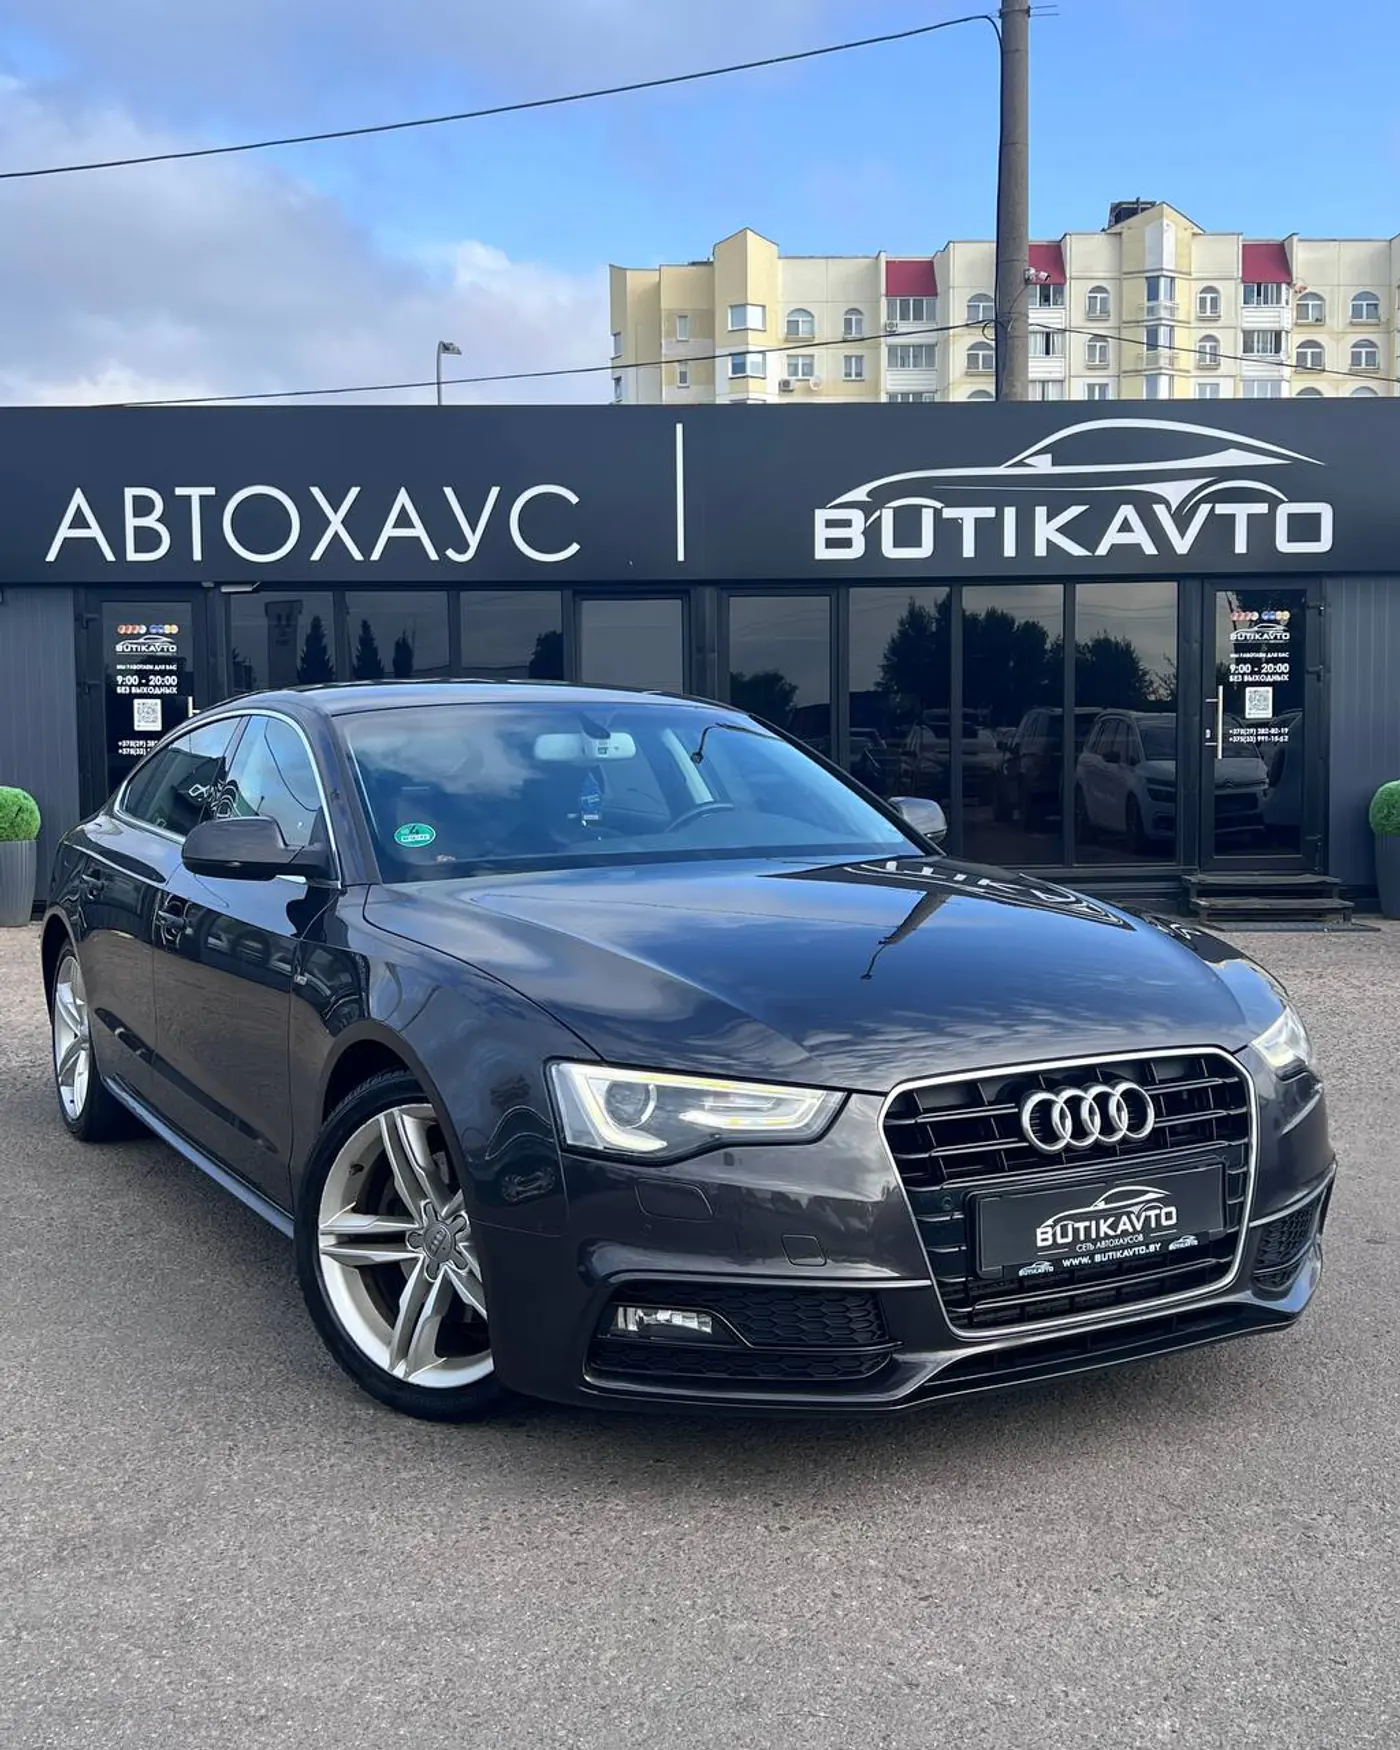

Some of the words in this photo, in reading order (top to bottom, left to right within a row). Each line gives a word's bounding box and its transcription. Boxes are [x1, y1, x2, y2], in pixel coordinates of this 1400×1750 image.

[45, 484, 581, 563] АВТОХАУС
[814, 500, 1334, 560] BUTIKAVTO
[1230, 632, 1290, 640] BUTIKAVTO
[115, 644, 177, 652] BUTIKAVTO
[1229, 664, 1252, 674] 9:00
[1260, 663, 1290, 673] 20:00
[116, 675, 140, 686] 9:00
[148, 675, 178, 686] 20:00
[1229, 674, 1243, 682] БЕЗ
[1243, 674, 1290, 682] ВЫХОДНЫХ
[116, 686, 130, 695] БЕЗ
[131, 686, 178, 695] ВЫХОДНЫХ
[1036, 1206, 1177, 1247] BUTIKAVTO
[1076, 1242, 1095, 1252] СЕТЬ
[1096, 1233, 1144, 1249] АВТОХАУСОВ
[1062, 1256, 1091, 1267] WWW.
[1094, 1242, 1161, 1262] BUTIKAVTO.BY
